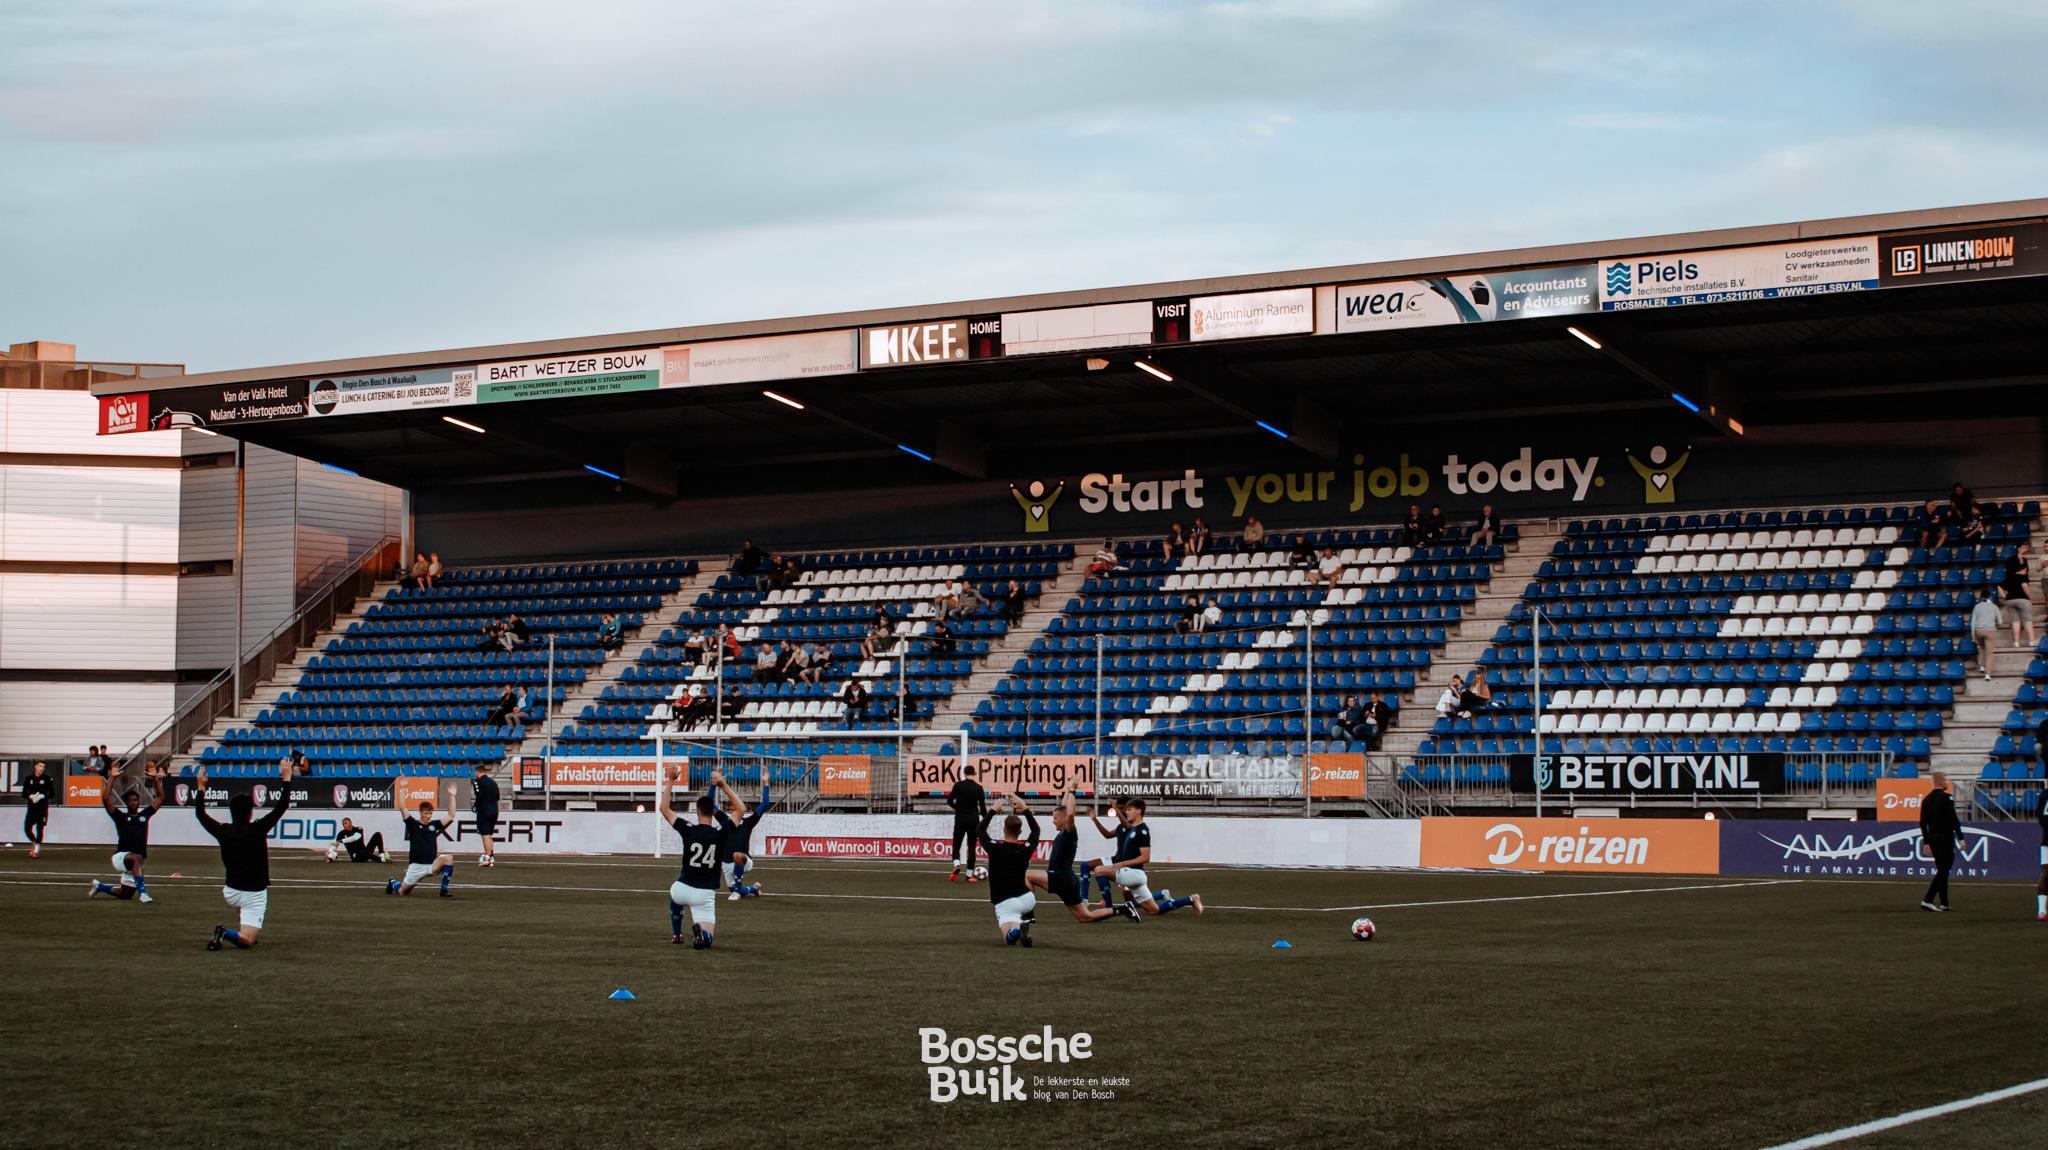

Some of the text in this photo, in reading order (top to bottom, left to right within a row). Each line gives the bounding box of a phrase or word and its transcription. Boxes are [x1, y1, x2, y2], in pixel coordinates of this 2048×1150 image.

[1785, 244, 1868, 259] Loodgieterswerken
[1924, 236, 2014, 264] LINNENBOUW
[1785, 257, 1870, 271] CV werkzaamheden
[1637, 259, 1699, 285] Piels
[1785, 273, 1819, 284] Sanitair
[1503, 276, 1588, 296] Accountants
[1637, 278, 1746, 296] technische installaties B.V.
[1503, 293, 1591, 311] en Adviseurs
[1614, 297, 1668, 311] ROSMALEN
[1680, 294, 1705, 306] TEL.:
[1706, 290, 1764, 303] 073-5219106
[1777, 281, 1865, 297] WWW.PIELSBV.NL
[1157, 304, 1187, 318] VISIT
[1205, 303, 1304, 321] Aluminium Ramen
[1345, 312, 1426, 324] ACCOUNTANTS ADVISEURS
[970, 320, 1000, 335] HOME
[490, 354, 647, 380] BART WETZER BOUW
[667, 361, 687, 373] BIM
[694, 359, 716, 368] maakt
[717, 356, 761, 366] ondernemen
[801, 361, 854, 374] www.nvbim.nl
[342, 381, 358, 390] Regio
[358, 380, 370, 388] Den
[370, 377, 387, 386] Bosch
[392, 375, 417, 385] Waalwijk
[563, 378, 597, 386] BEHANGWERK
[603, 374, 647, 383] STUCADOORWERK
[223, 386, 288, 403] Van der Valk Hotel
[342, 386, 450, 403] LUNCH & CATERING BIJ JOU BEZORGD!
[210, 408, 236, 421] Nuland
[1079, 446, 1605, 518] Start your job today.
[824, 766, 867, 781] D-reizen
[1310, 766, 1360, 781] D-reizen
[1559, 756, 1760, 788] BETCITY.NL
[69, 785, 101, 797] D-reizen
[1098, 784, 1162, 795] SCHOONMAAK
[1164, 784, 1171, 795] &
[1173, 784, 1223, 795] FACILITAIR
[1238, 784, 1258, 795] MET
[800, 840, 823, 853] Van
[826, 840, 880, 856] Wanrooij
[884, 841, 920, 855] Bouw
[922, 842, 931, 855] &
[1485, 823, 1649, 864] D-reizen
[689, 842, 716, 868] 24
[1783, 865, 1811, 873] THE
[1821, 865, 1897, 875] AMAZING
